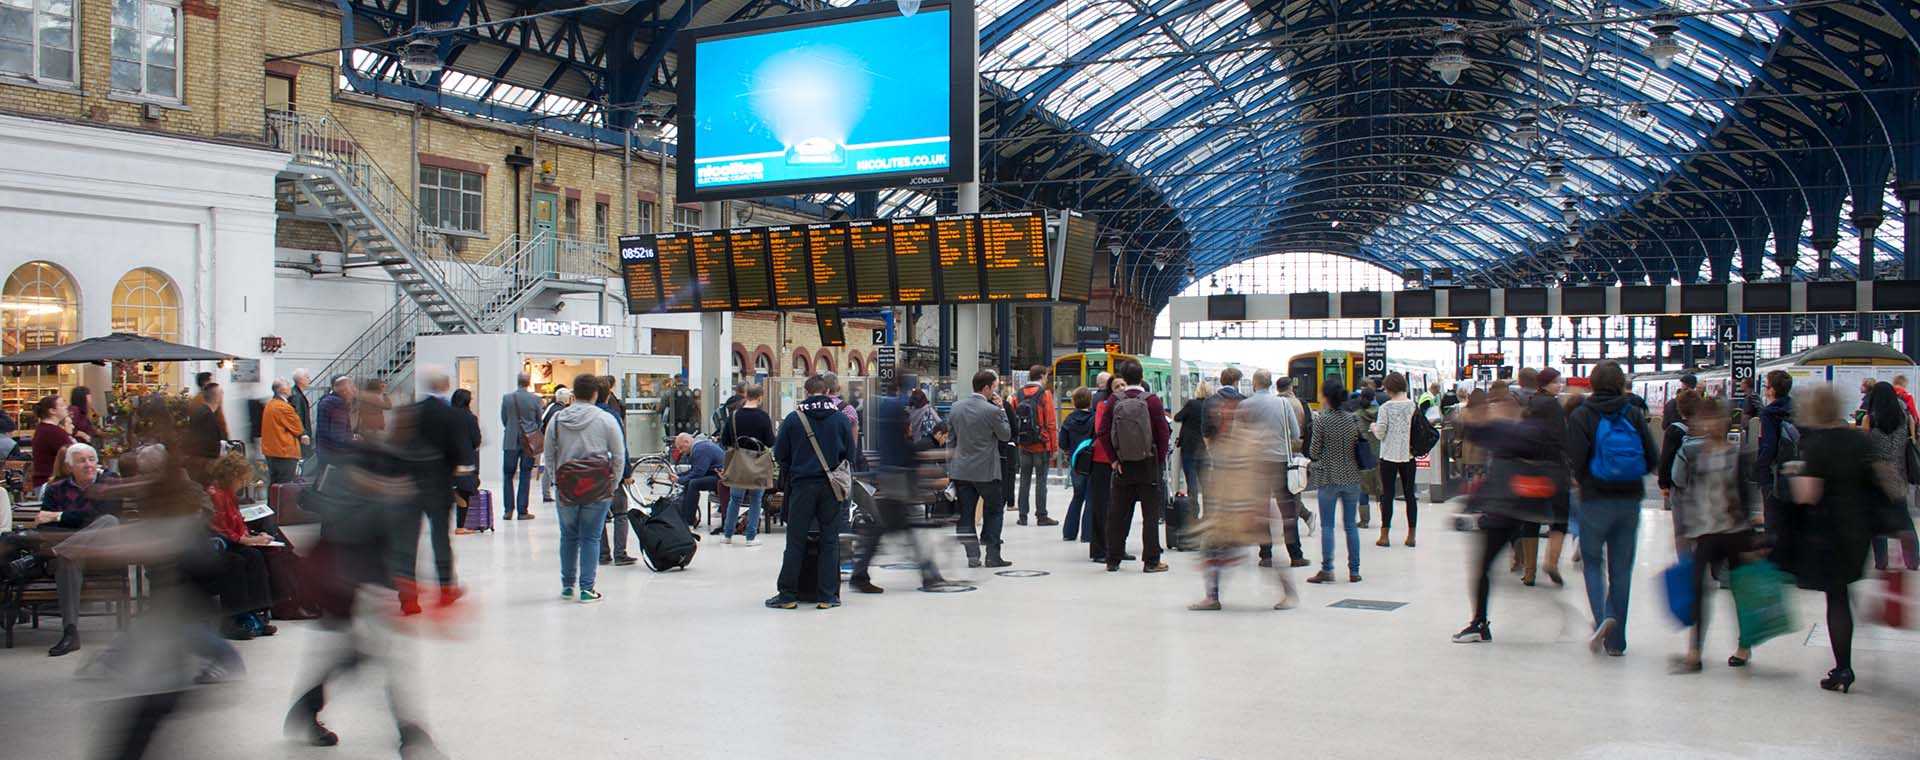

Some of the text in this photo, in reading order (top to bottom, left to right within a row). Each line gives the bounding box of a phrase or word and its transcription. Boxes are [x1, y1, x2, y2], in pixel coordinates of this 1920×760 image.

[909, 177, 944, 185] JCDecaux
[570, 320, 612, 338] France
[1723, 327, 1733, 340] 4
[875, 331, 883, 343] 2
[1367, 359, 1384, 371] 30
[880, 368, 894, 380] 30
[1735, 366, 1753, 379] 30
